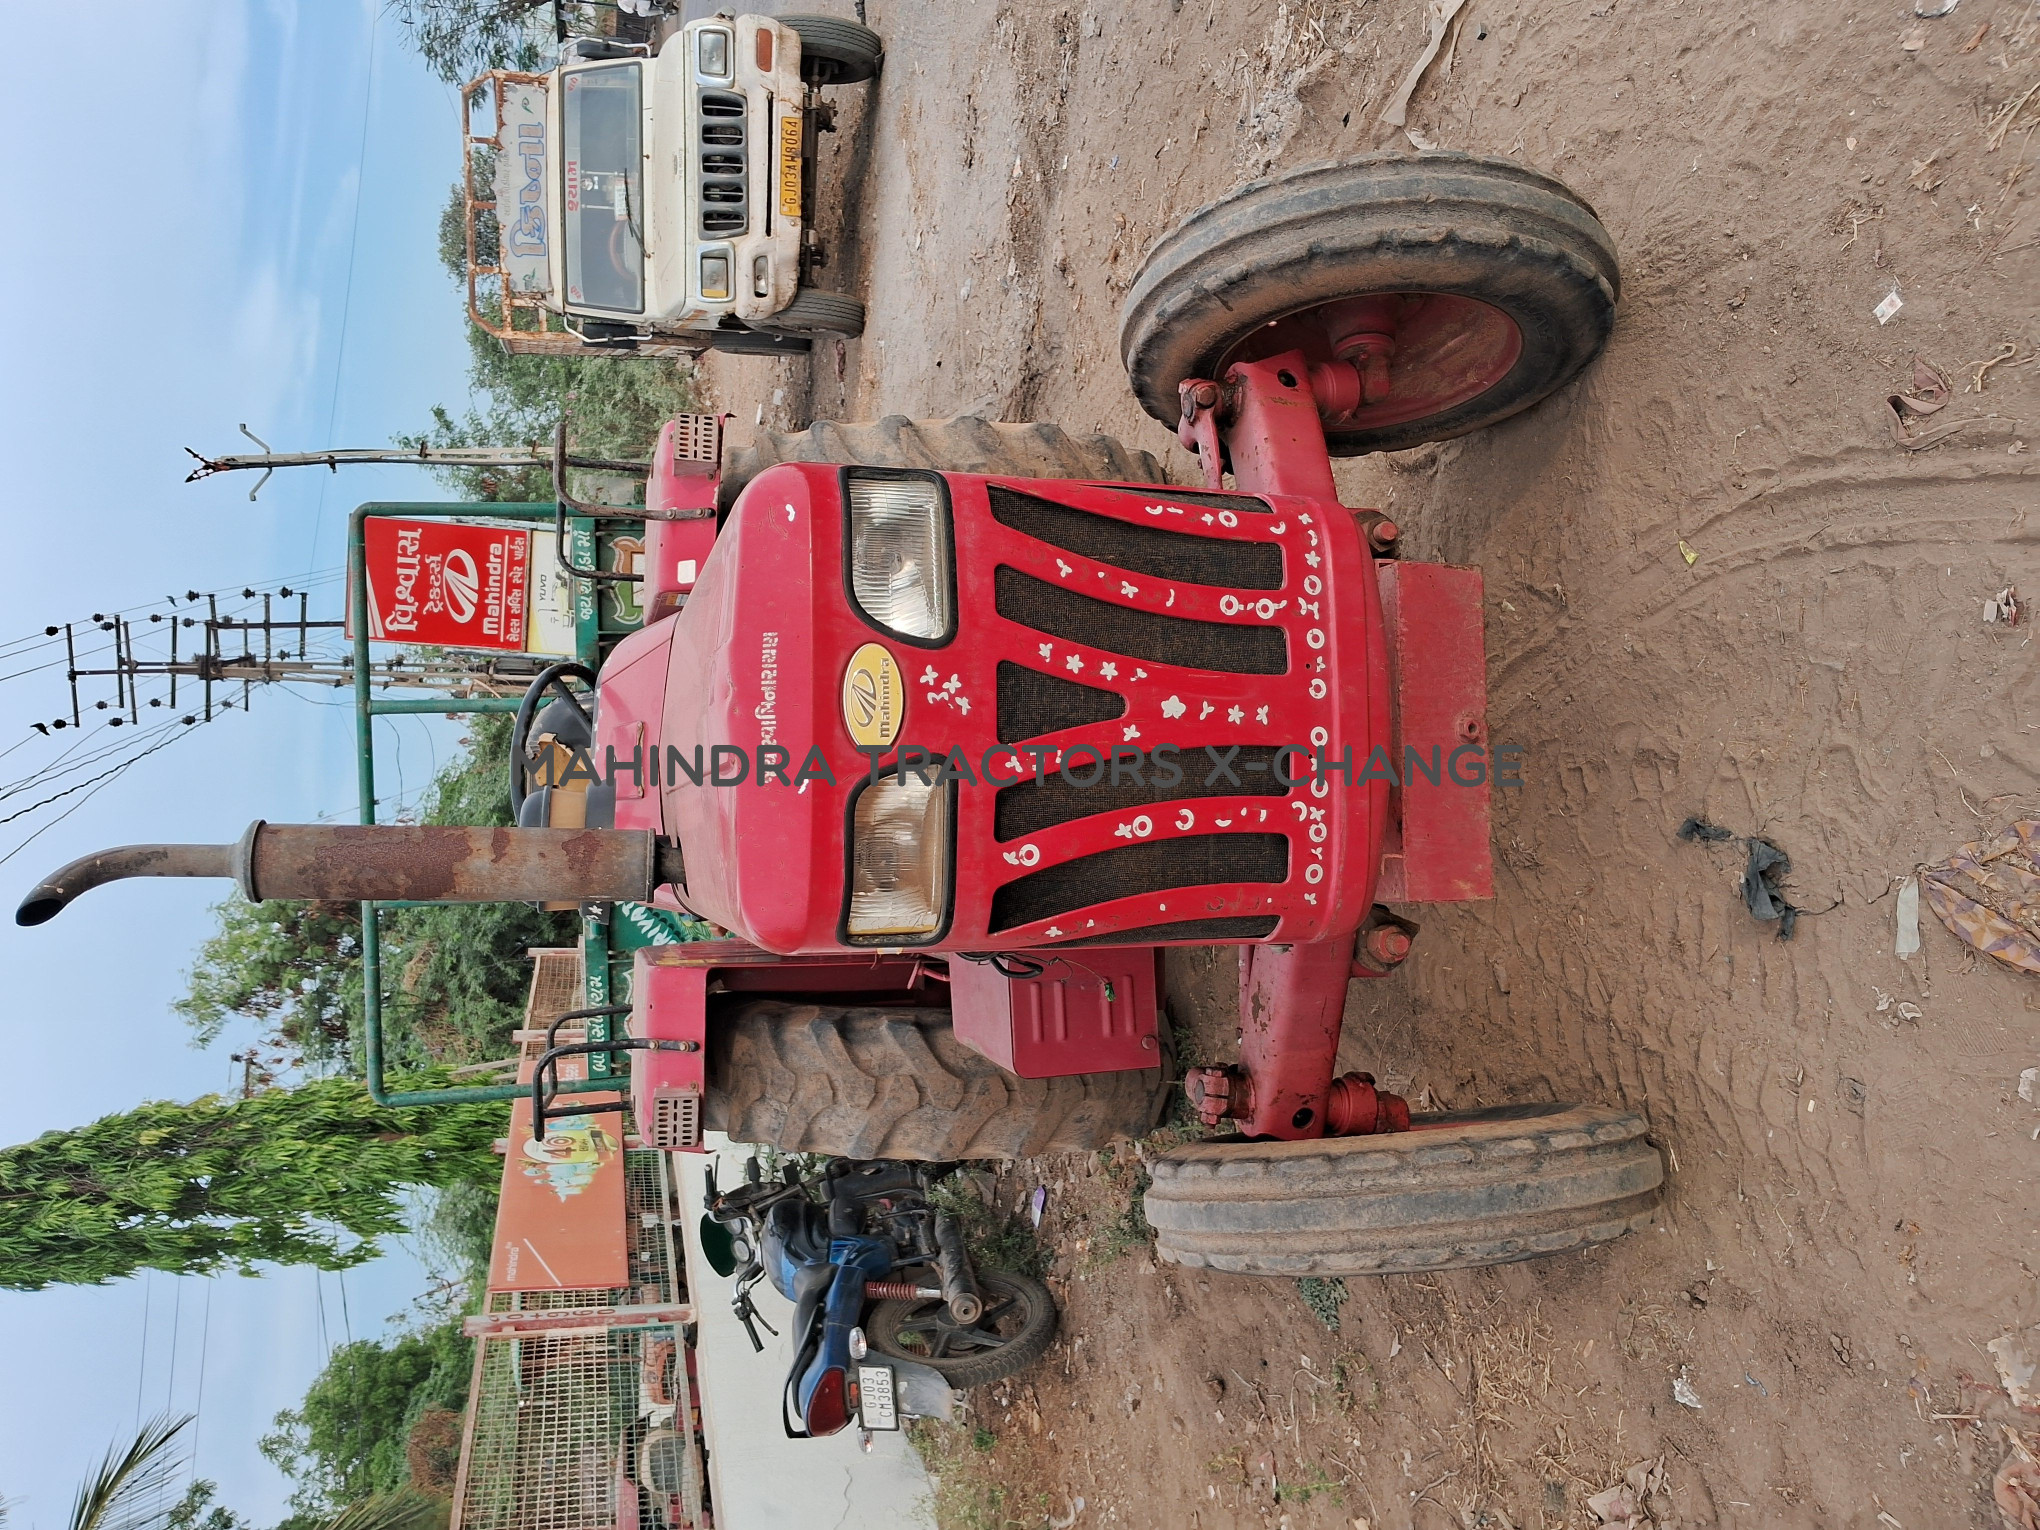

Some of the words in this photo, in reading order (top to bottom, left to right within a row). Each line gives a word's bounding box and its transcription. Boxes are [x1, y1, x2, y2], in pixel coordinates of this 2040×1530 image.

[509, 122, 547, 258] ક્રિષ્ના
[385, 528, 422, 631] વિશ્વાસ
[539, 573, 547, 601] YUVO
[579, 595, 593, 621] જય
[879, 657, 891, 738] Mahindra
[862, 1377, 877, 1408] GJ03
[876, 1370, 892, 1417] CM3853
